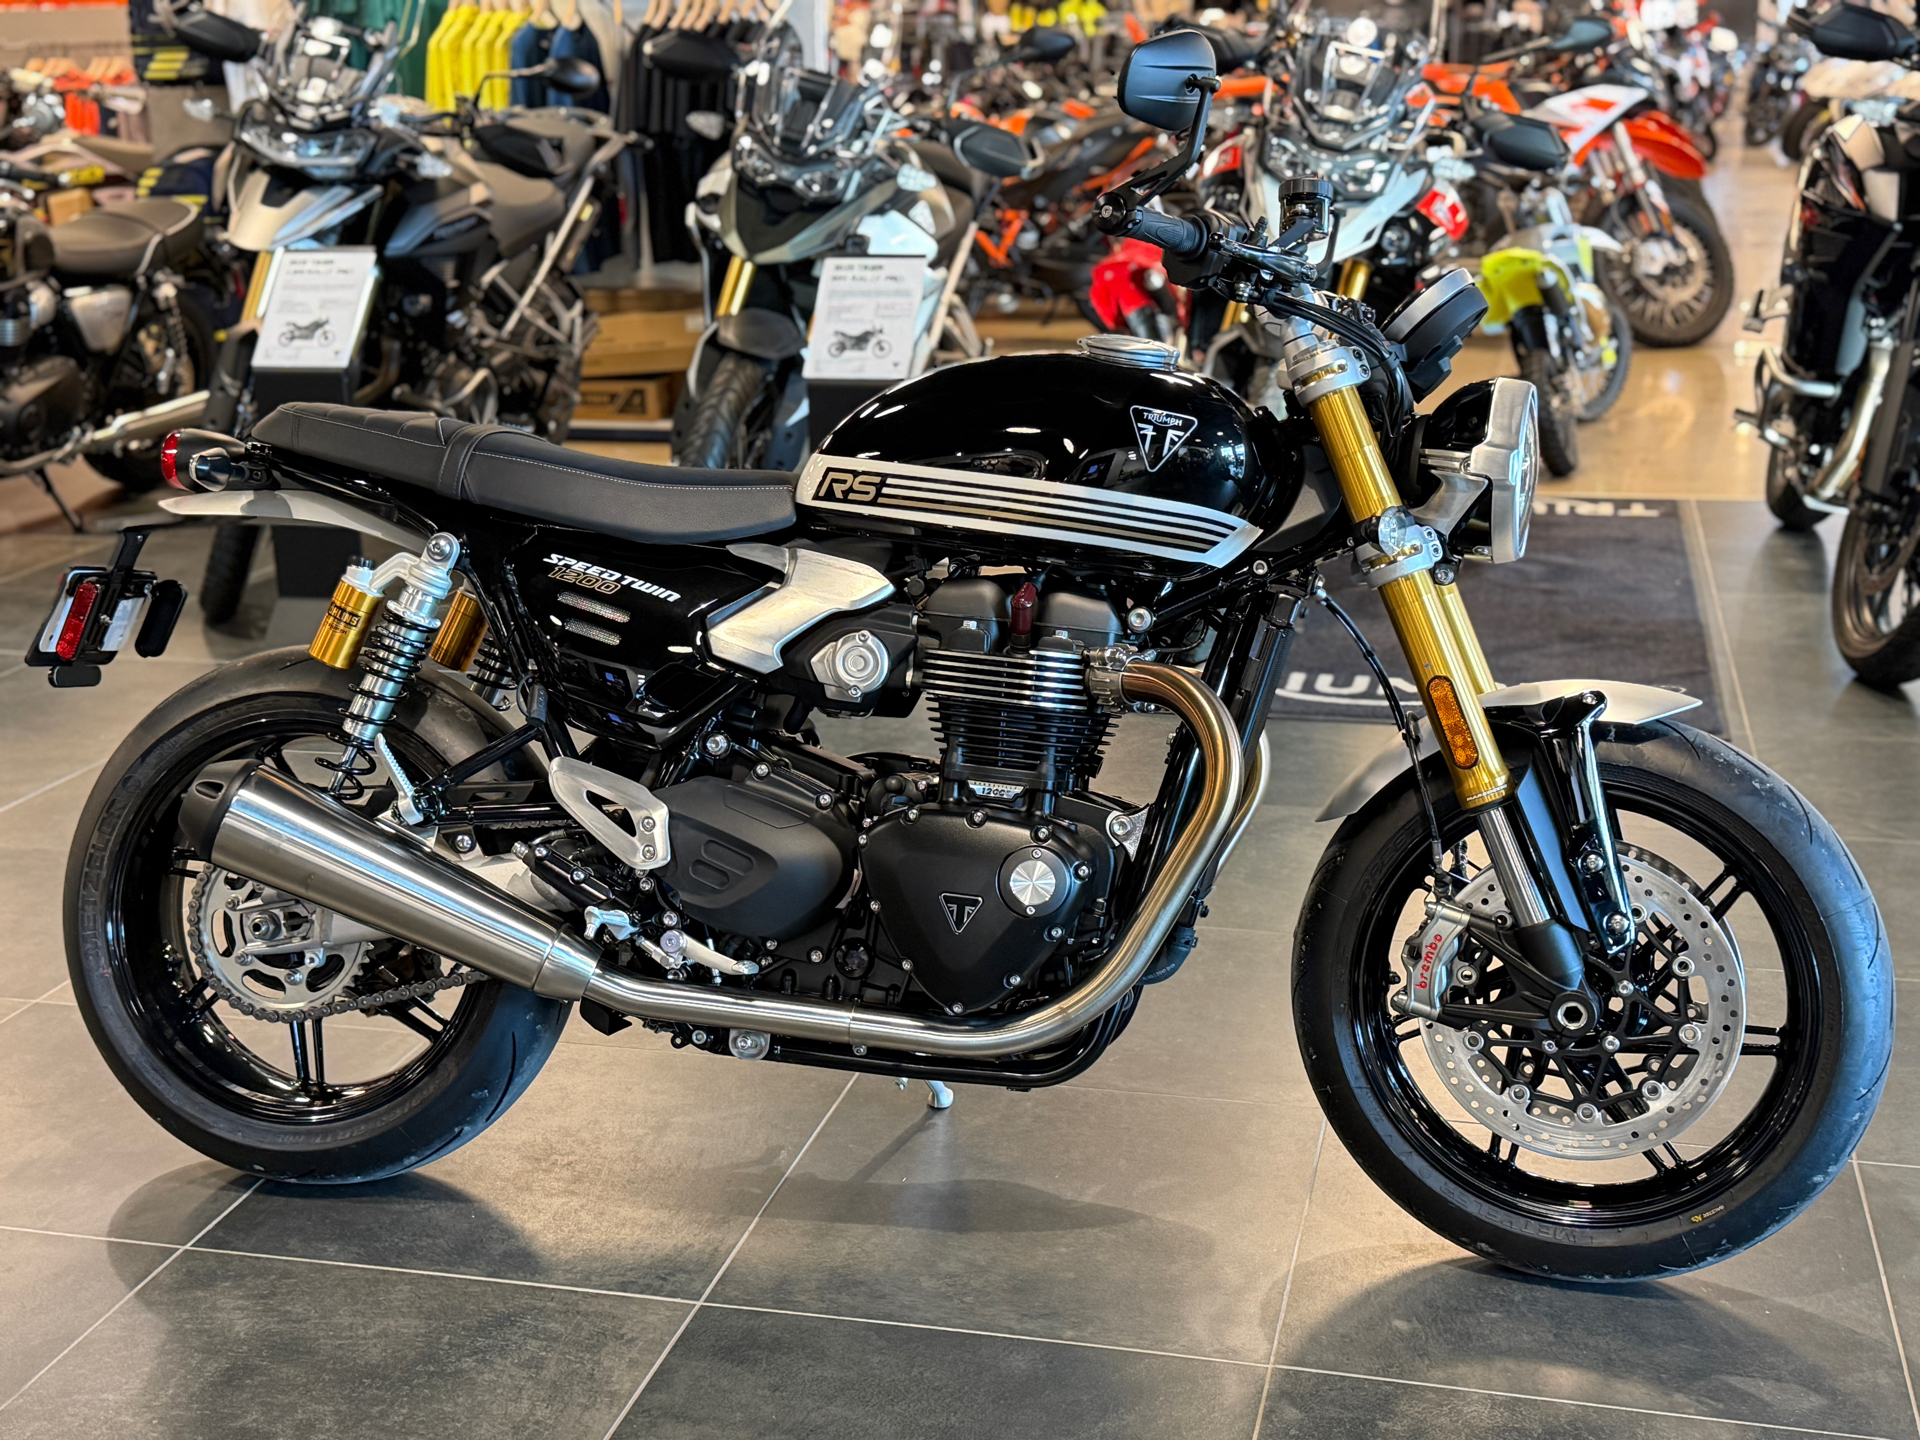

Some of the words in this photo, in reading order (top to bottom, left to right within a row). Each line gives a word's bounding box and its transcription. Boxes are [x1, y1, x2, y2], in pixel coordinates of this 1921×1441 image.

[1143, 411, 1183, 427] TRIUMPH
[818, 471, 882, 502] RS
[543, 553, 622, 581] SPEED
[621, 575, 682, 603] TWIN
[548, 566, 622, 595] 1200
[1414, 933, 1443, 990] brembo
